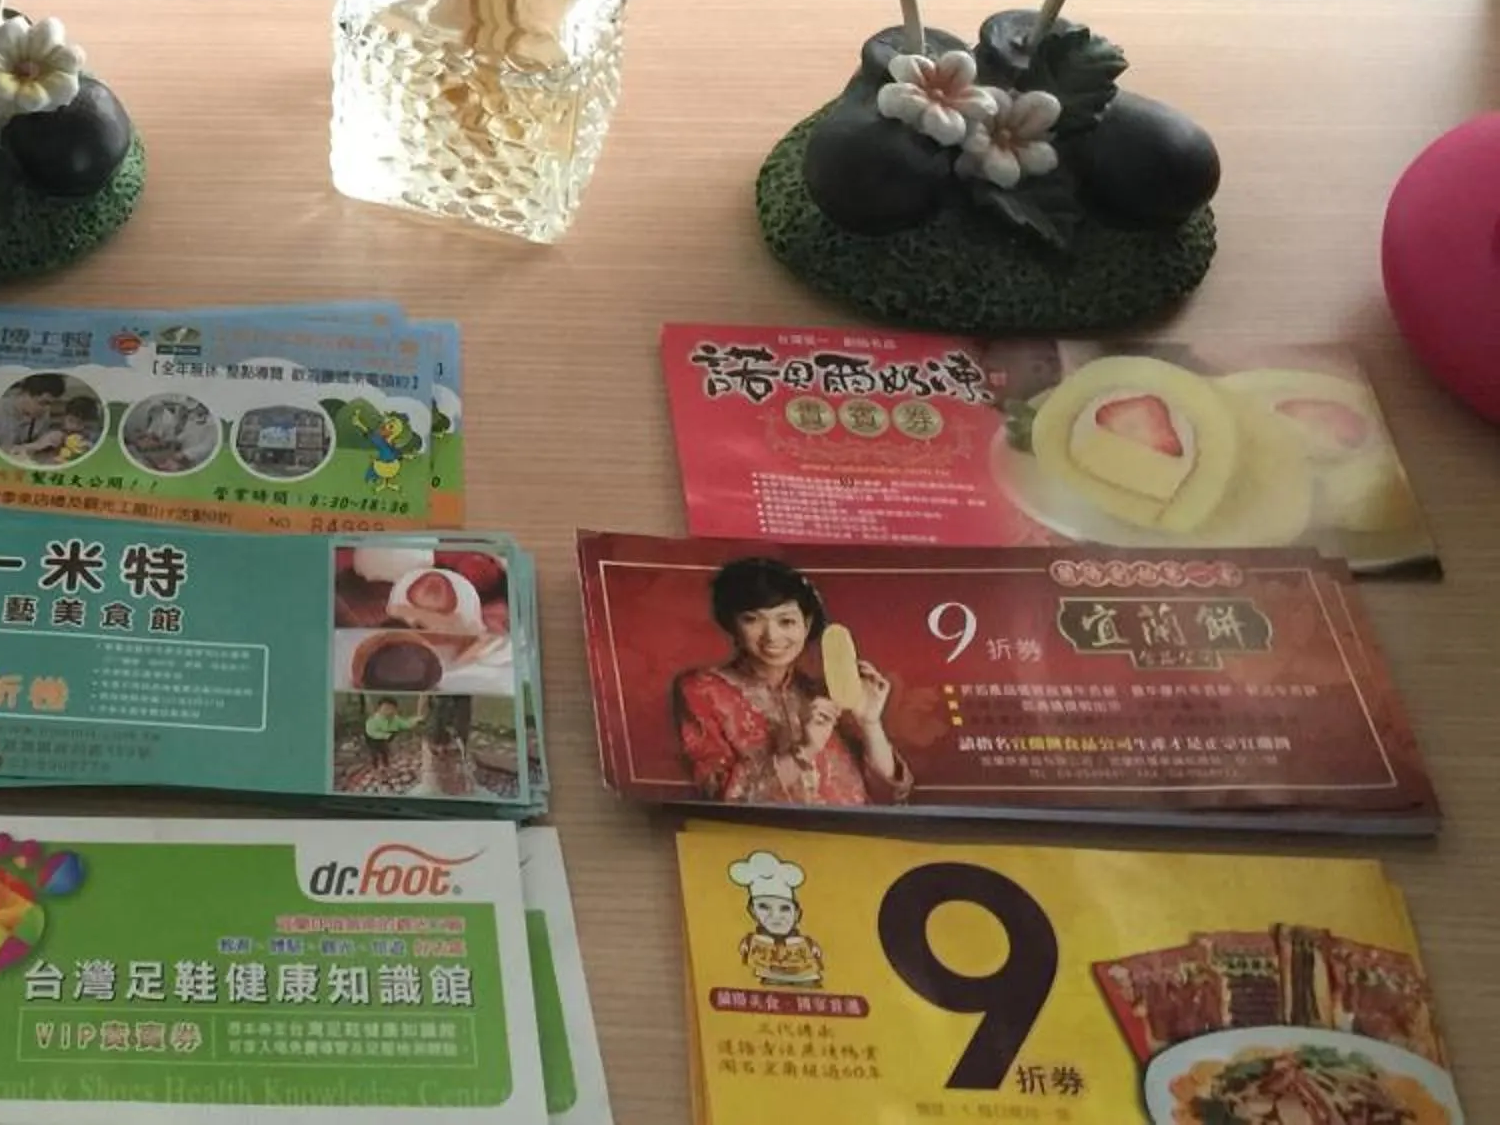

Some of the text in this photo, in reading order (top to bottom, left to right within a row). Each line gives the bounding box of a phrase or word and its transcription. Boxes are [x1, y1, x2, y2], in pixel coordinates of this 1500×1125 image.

[927, 602, 977, 664] 9
[309, 843, 454, 896] dr.foot
[23, 958, 476, 1006] 台灣足鞋健康知識館
[877, 861, 1059, 1091] 9
[1016, 1064, 1085, 1096] 折券
